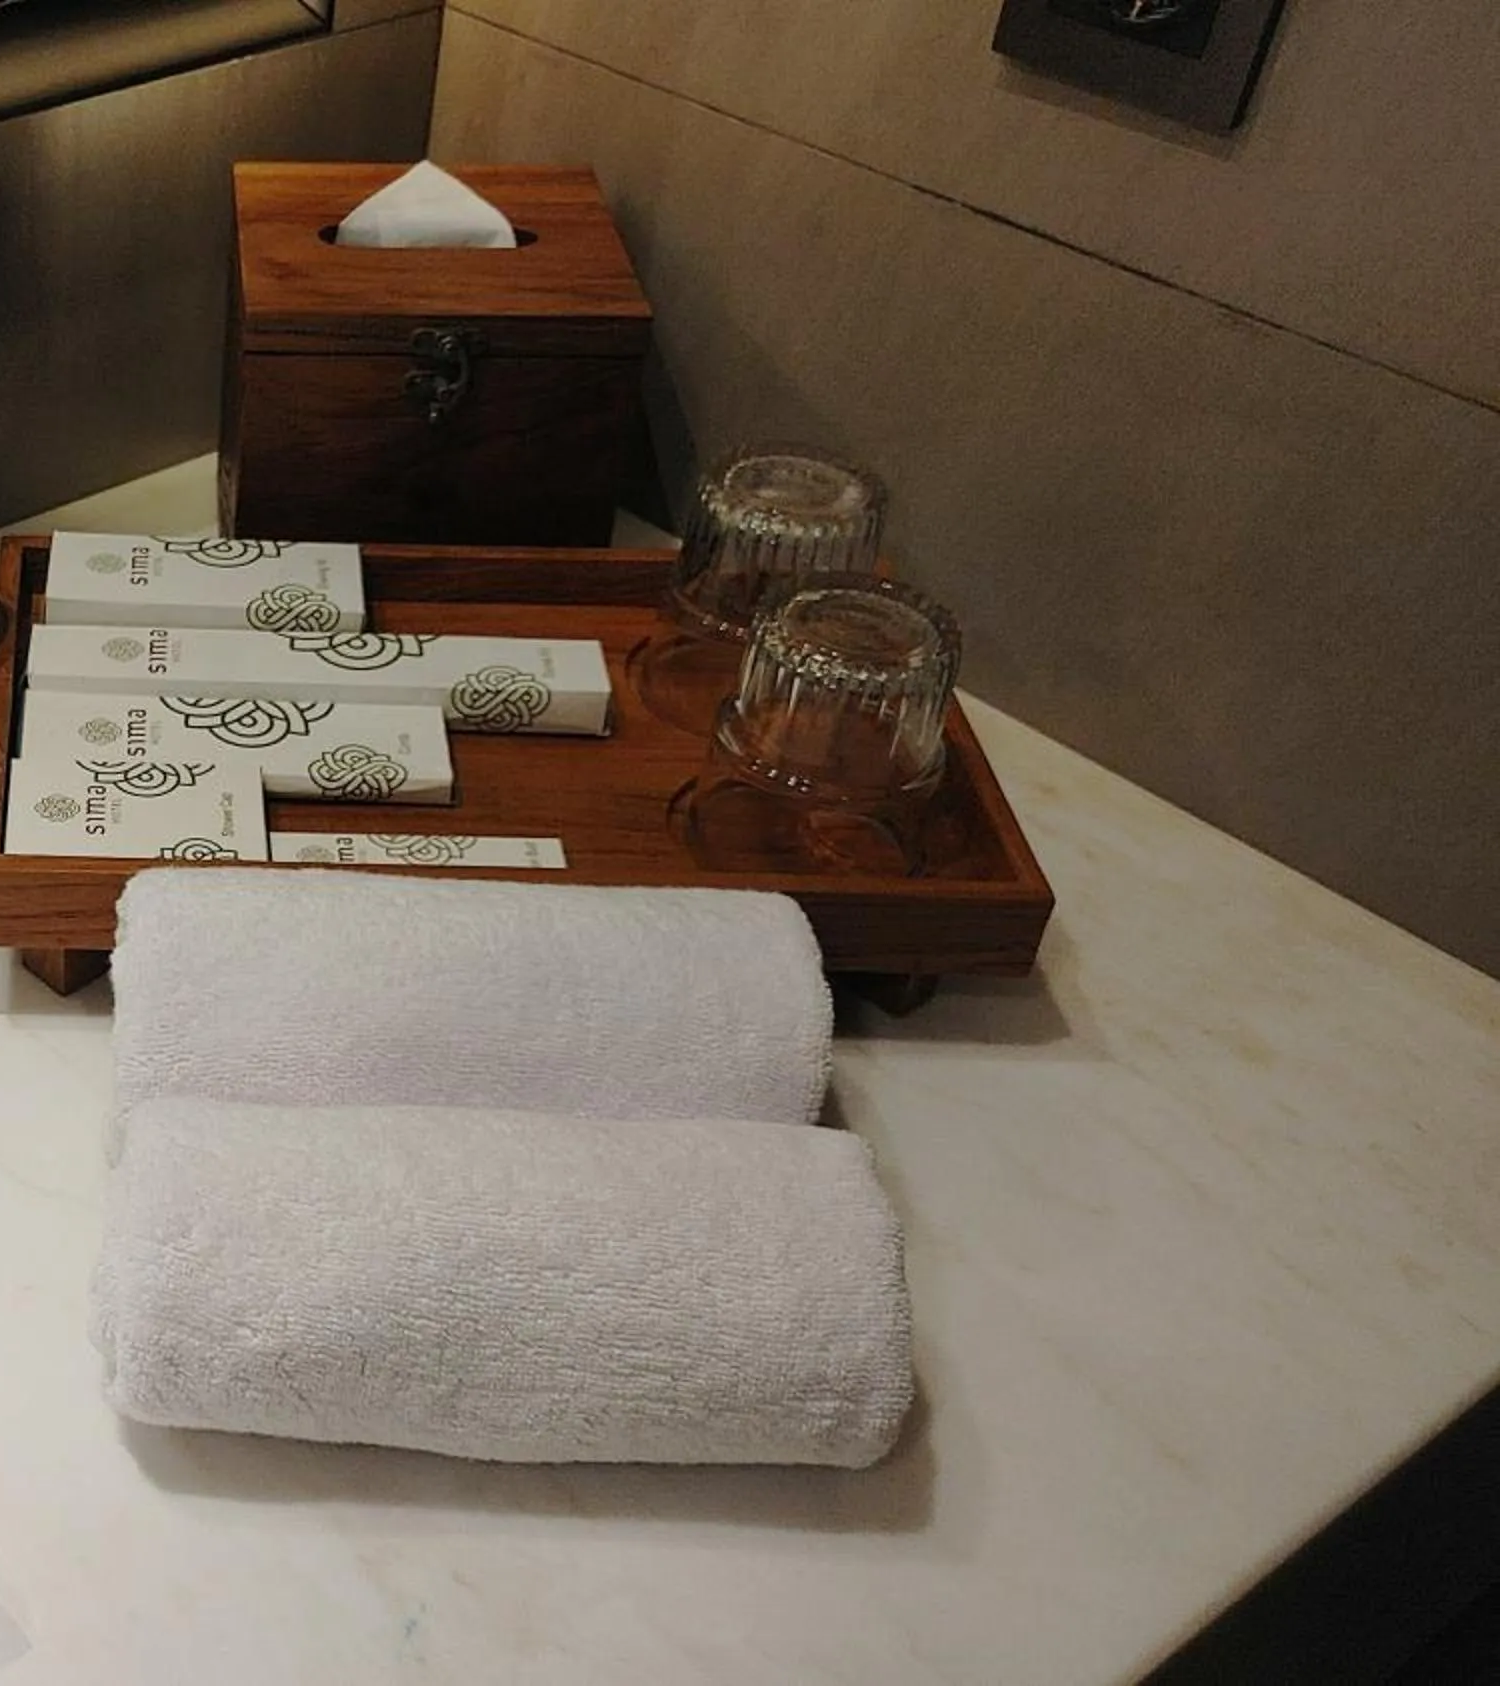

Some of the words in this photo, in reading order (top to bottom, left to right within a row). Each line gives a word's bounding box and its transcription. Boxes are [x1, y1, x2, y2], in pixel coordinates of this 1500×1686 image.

[130, 546, 149, 586] sima
[148, 629, 168, 675] sima
[127, 709, 147, 756] sima
[86, 785, 106, 835] sima
[336, 837, 355, 861] ma
